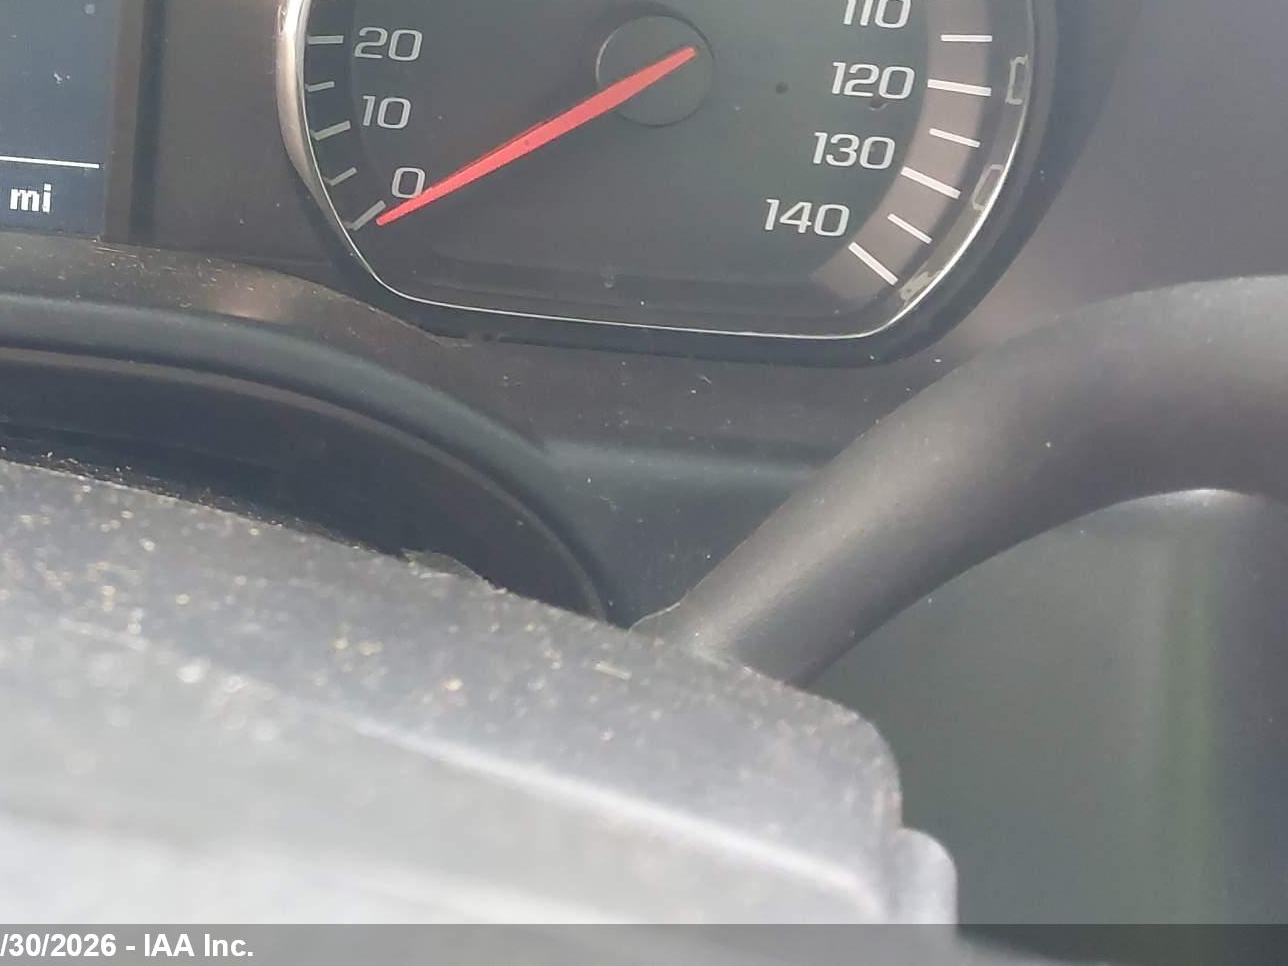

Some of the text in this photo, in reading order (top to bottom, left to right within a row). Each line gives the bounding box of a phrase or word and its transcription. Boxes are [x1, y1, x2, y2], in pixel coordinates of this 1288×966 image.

[354, 27, 423, 61] 20
[831, 61, 915, 99] 120
[362, 95, 412, 129] 10
[813, 131, 896, 170] 130
[9, 183, 52, 213] mi
[391, 167, 426, 199] 0
[765, 198, 850, 237] 140
